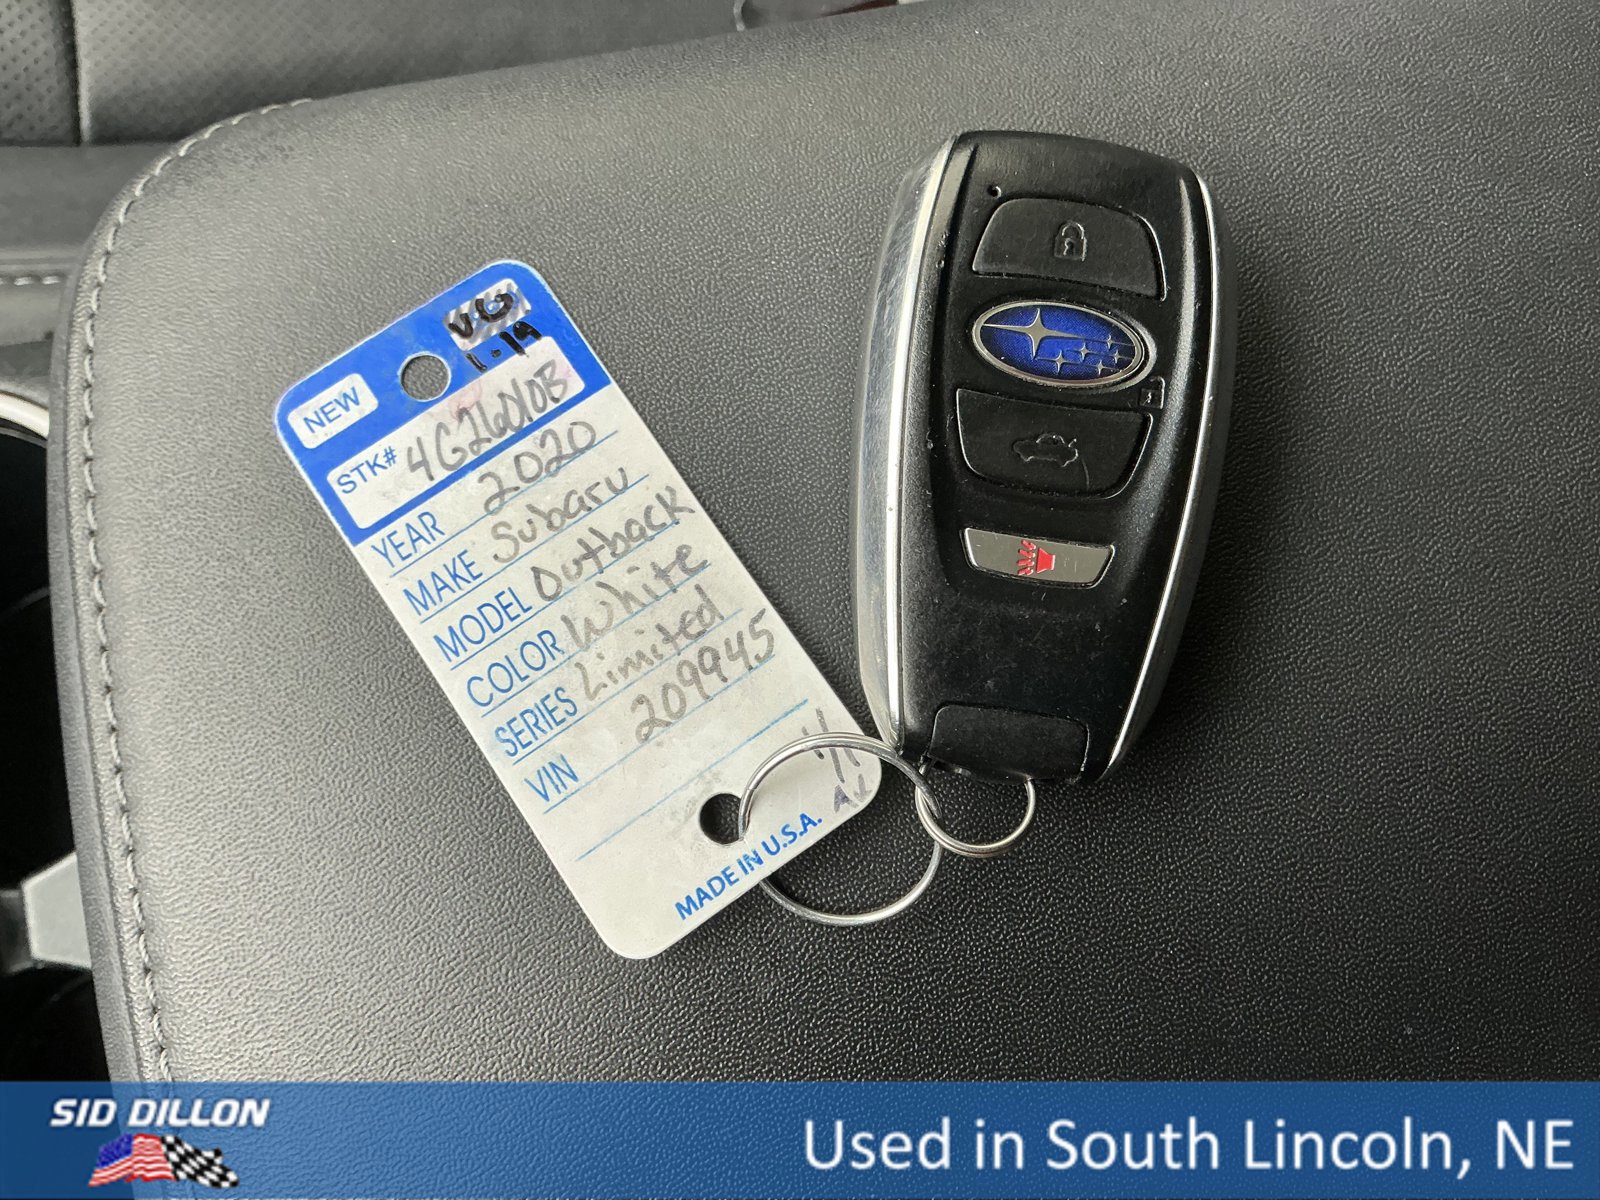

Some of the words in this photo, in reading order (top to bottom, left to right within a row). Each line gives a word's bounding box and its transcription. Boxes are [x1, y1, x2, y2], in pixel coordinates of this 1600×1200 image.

[302, 387, 362, 434] NEW
[336, 446, 397, 495] STK#
[478, 420, 597, 517] 2020
[371, 511, 446, 569] YEAR
[492, 467, 629, 564] Subaru
[531, 485, 696, 602] Outback
[402, 549, 484, 617] MAKE
[560, 544, 708, 651] White
[433, 586, 533, 663] MODEL
[574, 583, 725, 701] Limited
[466, 629, 565, 708] COLOR
[630, 608, 775, 743] 209945
[494, 686, 579, 758] SERIES
[523, 753, 580, 802] VIN
[674, 866, 740, 921] MADE
[736, 849, 765, 876] IN
[761, 812, 823, 856] U.S.A.
